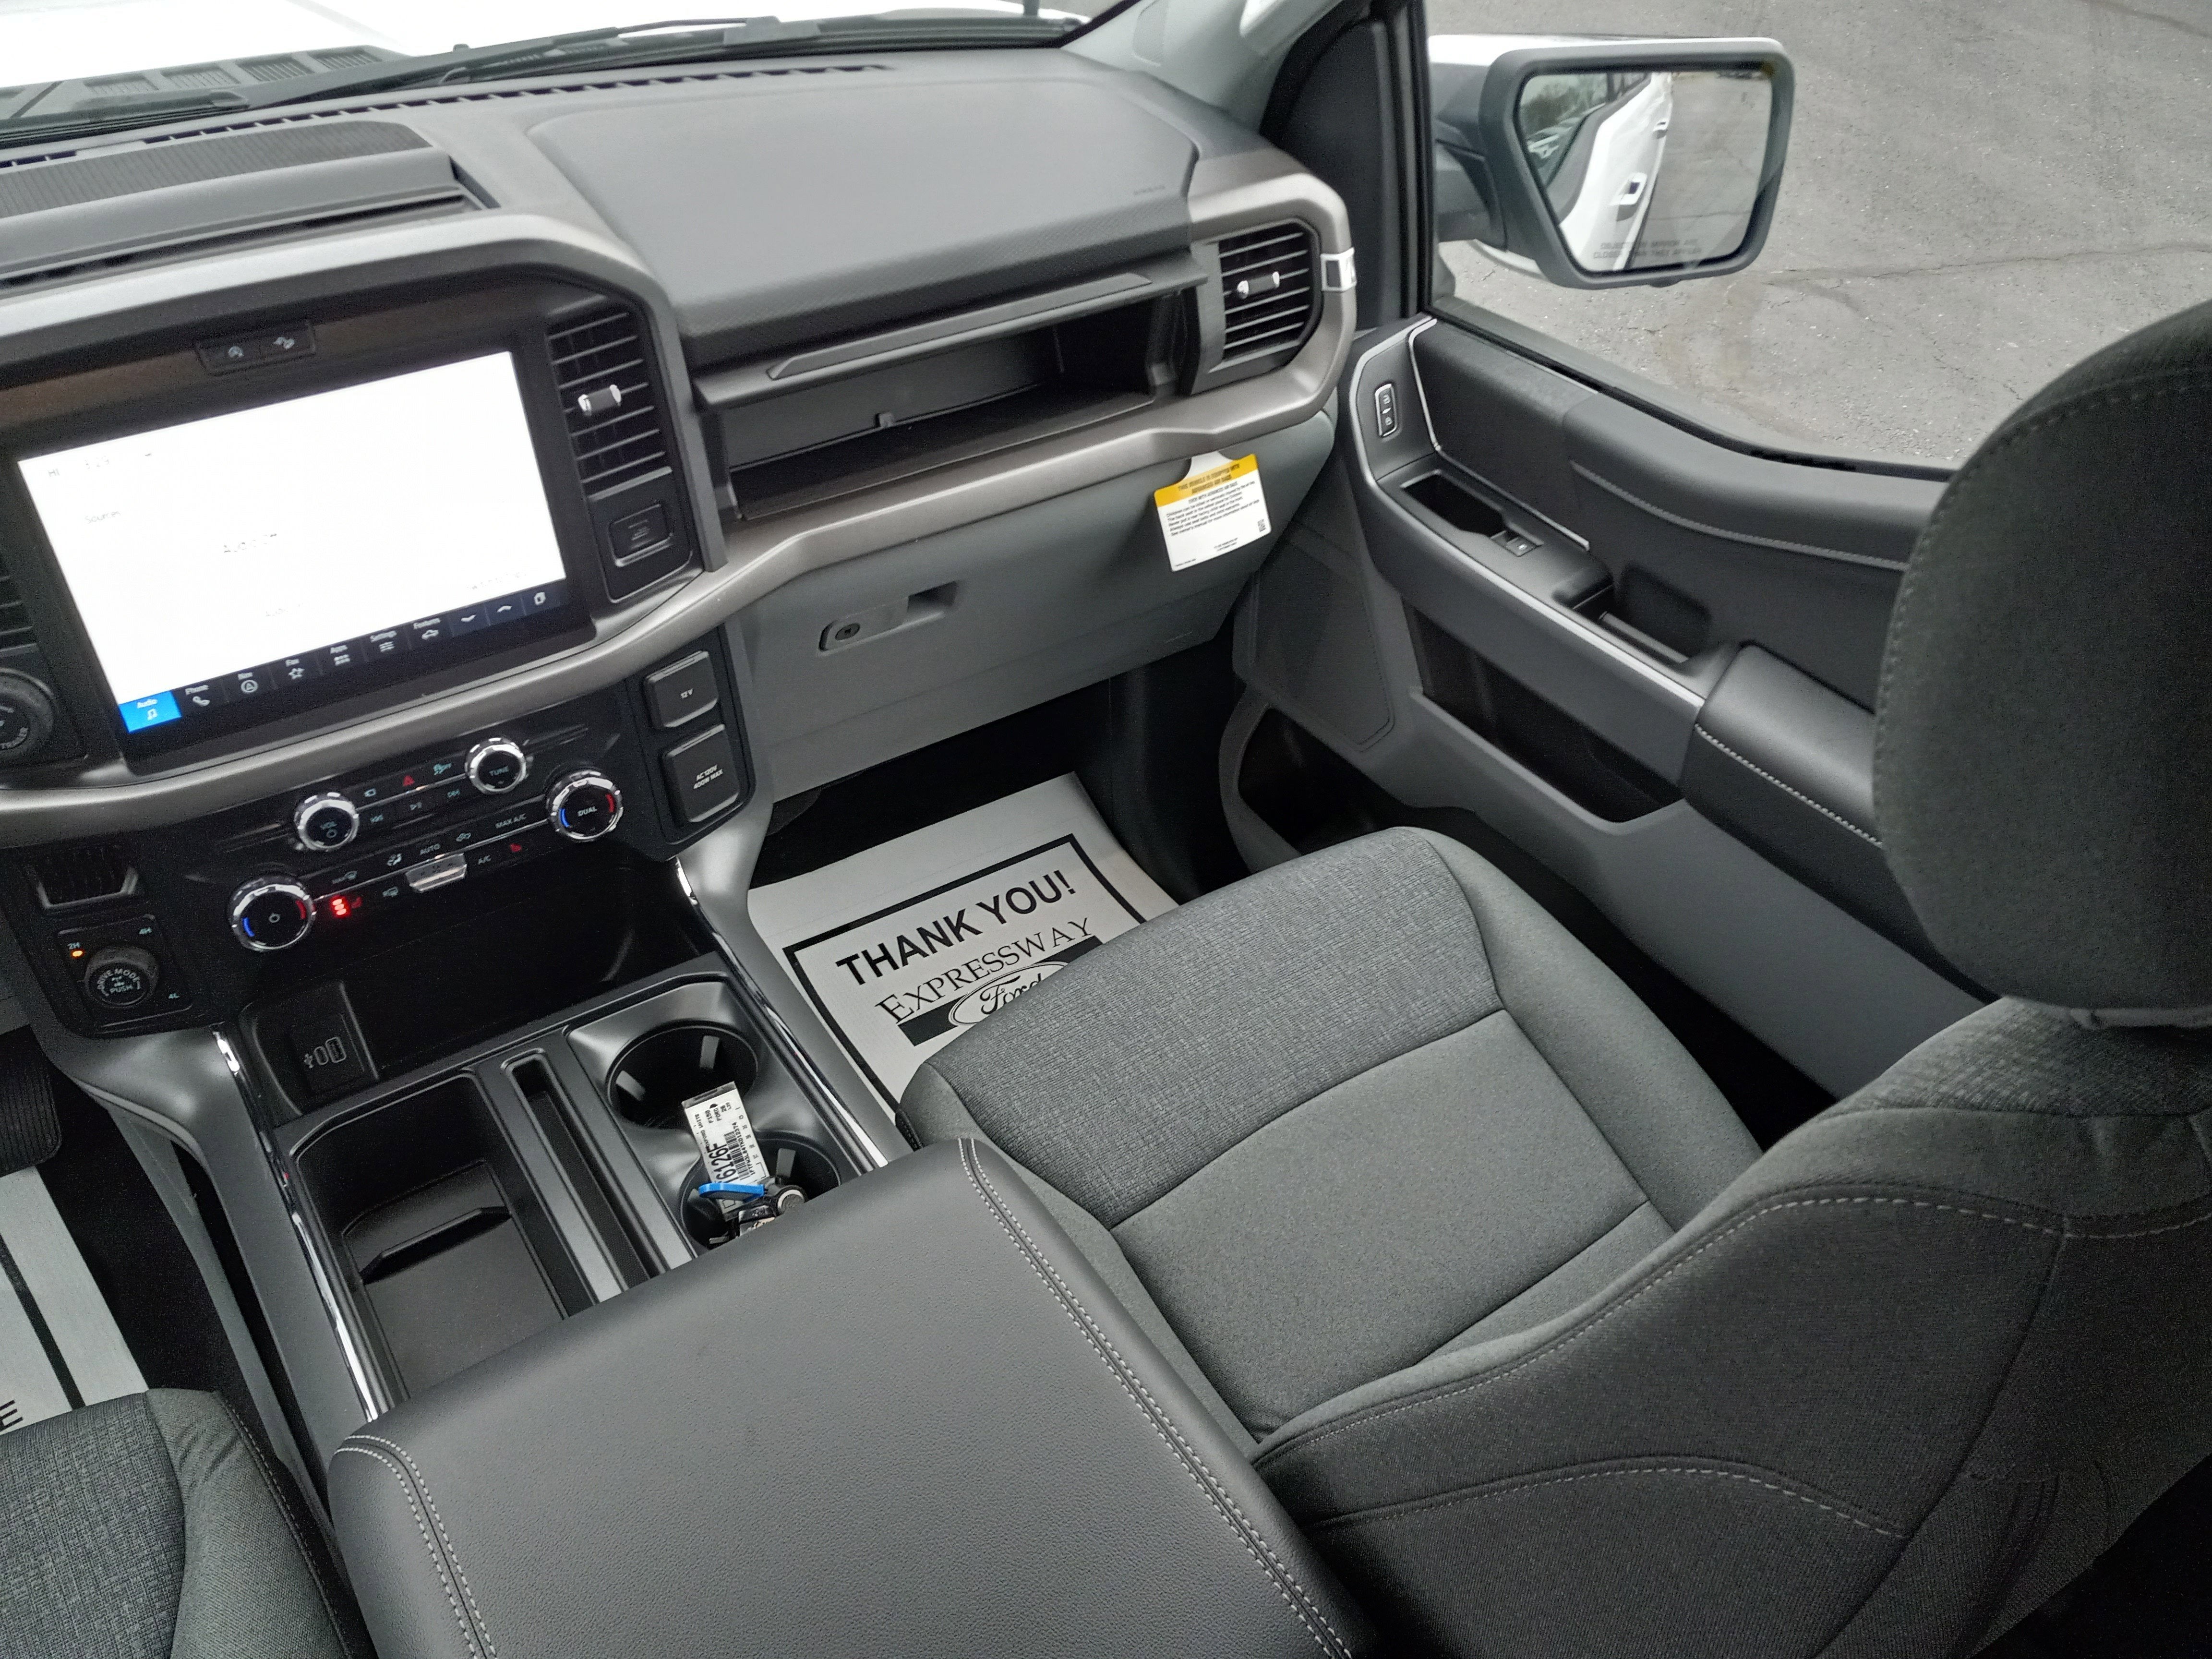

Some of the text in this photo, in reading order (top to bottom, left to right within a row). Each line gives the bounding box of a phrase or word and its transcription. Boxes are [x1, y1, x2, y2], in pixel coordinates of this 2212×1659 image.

[137, 699, 158, 709] Audio
[577, 806, 598, 817] DUAL
[495, 818, 512, 829] MAX
[420, 843, 441, 856] AUTO
[478, 855, 492, 865] A/C
[836, 869, 1076, 986] THANK YOU!
[875, 917, 1092, 1024] EXPRESSWAY
[705, 1110, 714, 1123] F150
[700, 1130, 710, 1148] OXFORD
